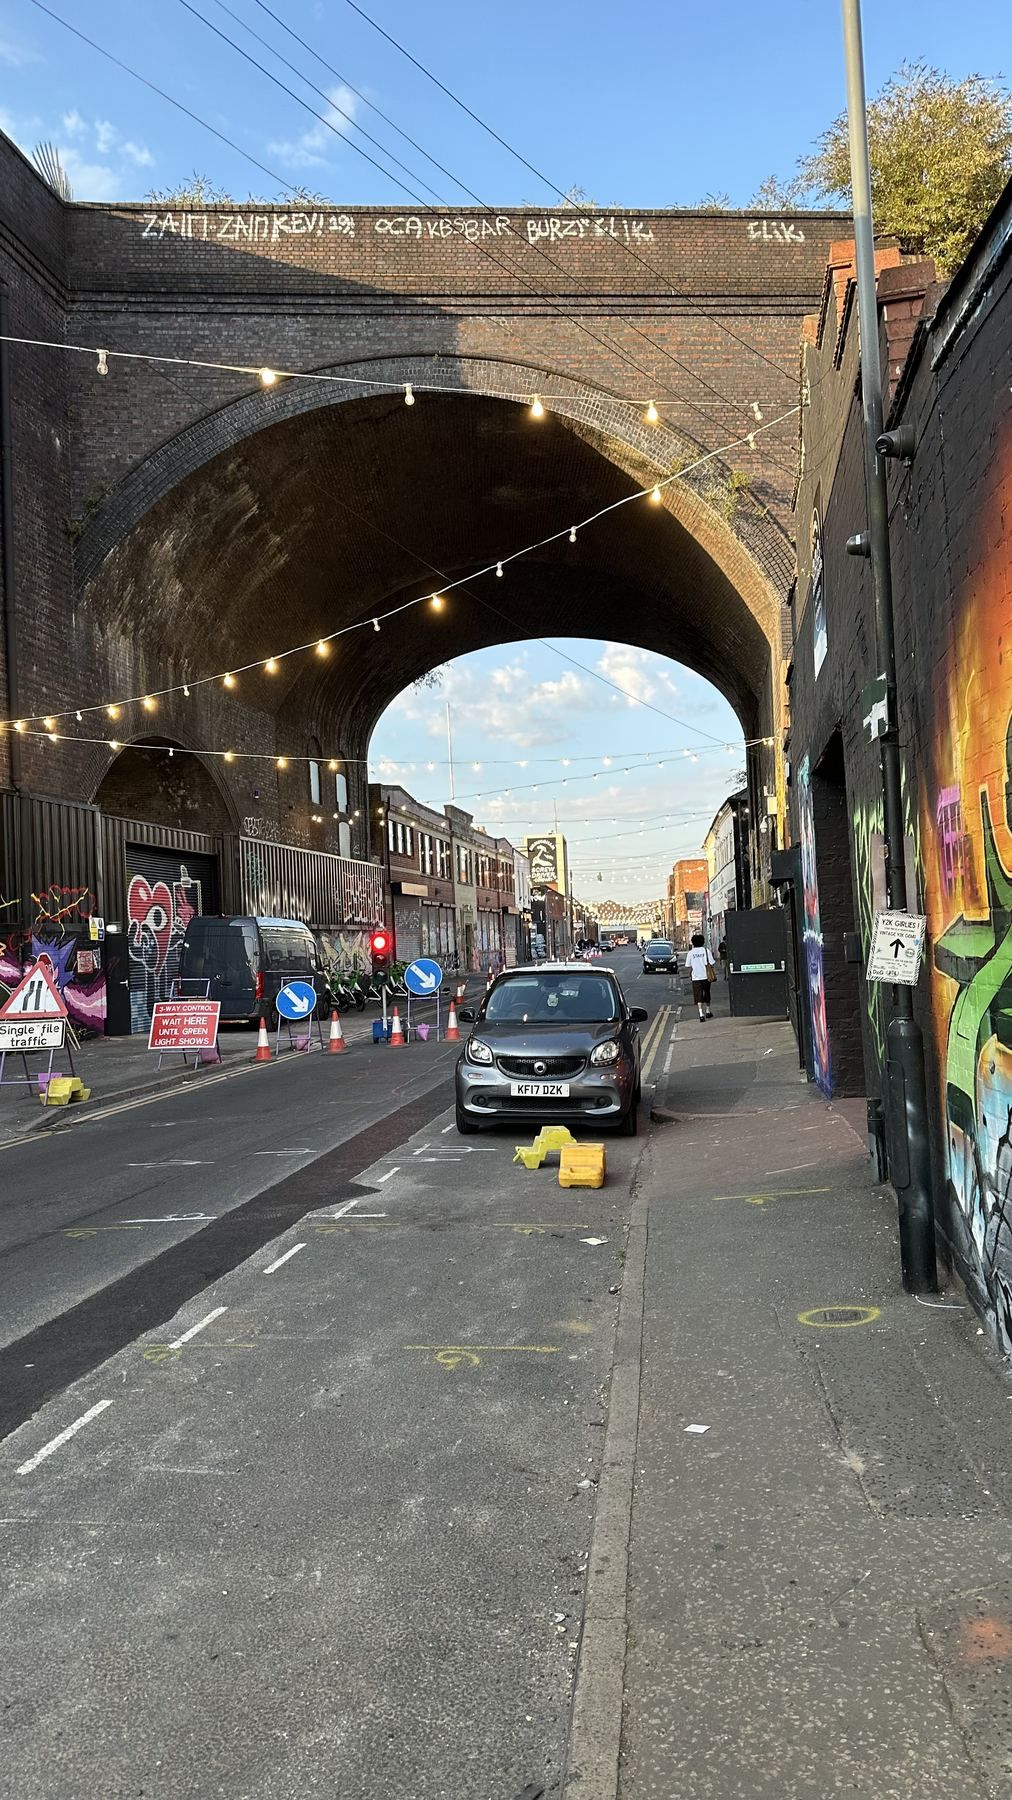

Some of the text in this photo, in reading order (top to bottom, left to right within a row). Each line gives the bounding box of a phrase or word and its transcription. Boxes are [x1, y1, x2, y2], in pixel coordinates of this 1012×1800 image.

[894, 920, 916, 928] GIRLIES
[162, 1017, 208, 1026] WAIT HERE
[0, 1024, 60, 1036] Single file
[158, 1027, 209, 1036] UNTIL GREEN
[11, 1036, 47, 1047] traffic
[154, 1037, 209, 1046] LIGHT SHOWS
[517, 1085, 563, 1095] KF17 DZK
